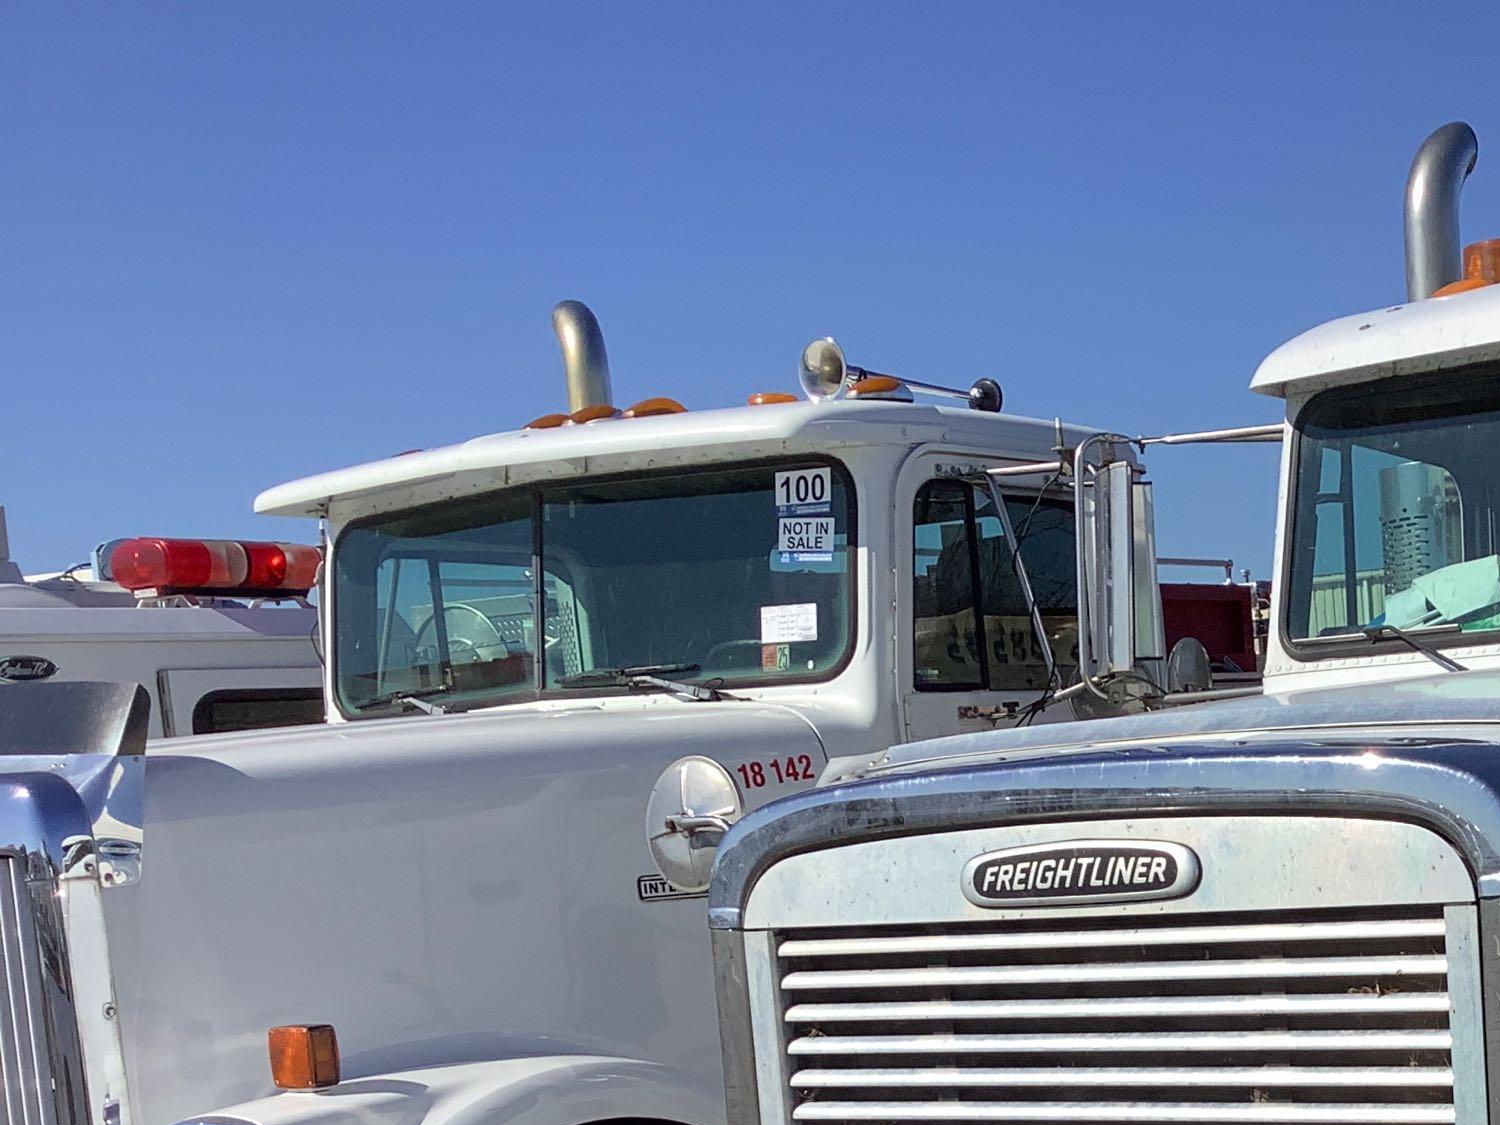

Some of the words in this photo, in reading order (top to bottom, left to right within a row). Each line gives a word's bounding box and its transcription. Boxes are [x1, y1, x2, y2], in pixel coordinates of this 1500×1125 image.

[780, 474, 825, 504] 100
[783, 522, 812, 535] NOT
[816, 522, 829, 535] IN
[787, 537, 823, 549] SALE
[778, 646, 788, 670] 25
[737, 761, 766, 789] 18
[769, 754, 815, 784] 142
[983, 856, 1168, 892] FREIGHTLINER
